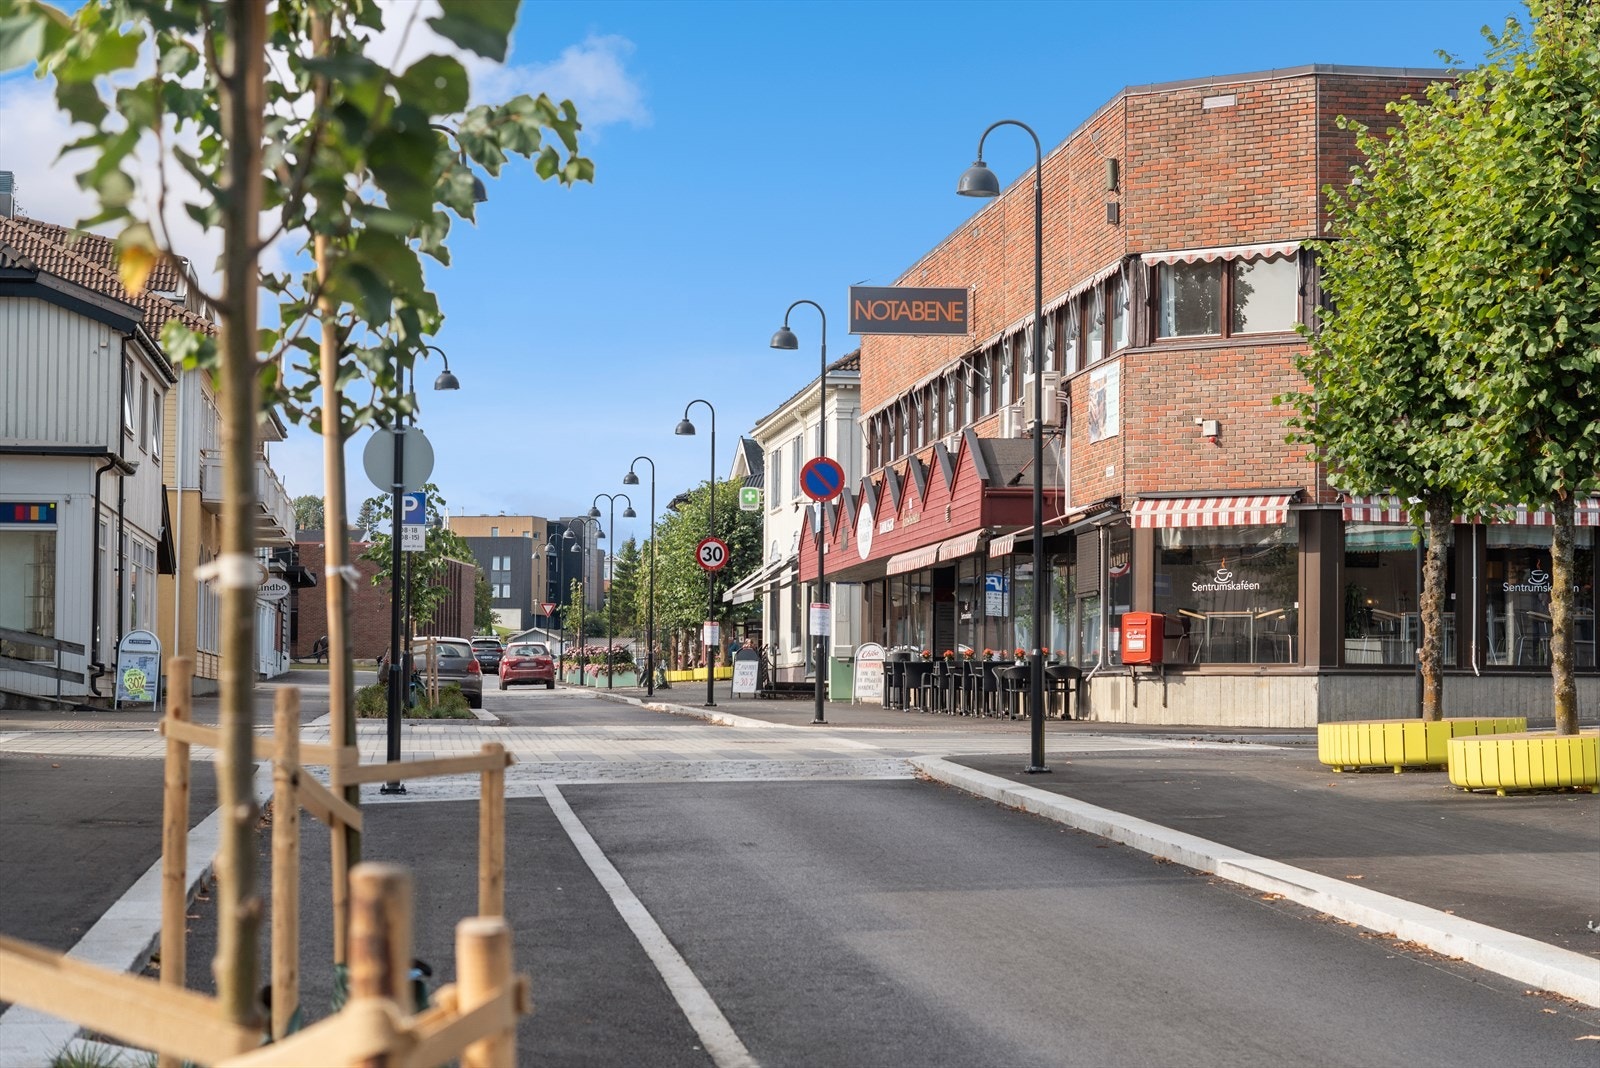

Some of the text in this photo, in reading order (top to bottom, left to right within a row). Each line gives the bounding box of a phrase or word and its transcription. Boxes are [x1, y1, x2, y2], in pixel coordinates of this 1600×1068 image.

[855, 299, 964, 322] NOTABENE
[401, 495, 418, 521] P
[702, 546, 723, 562] 30
[1191, 580, 1260, 592] Sentrumskaféen
[1502, 581, 1580, 592] Sentrumskn
